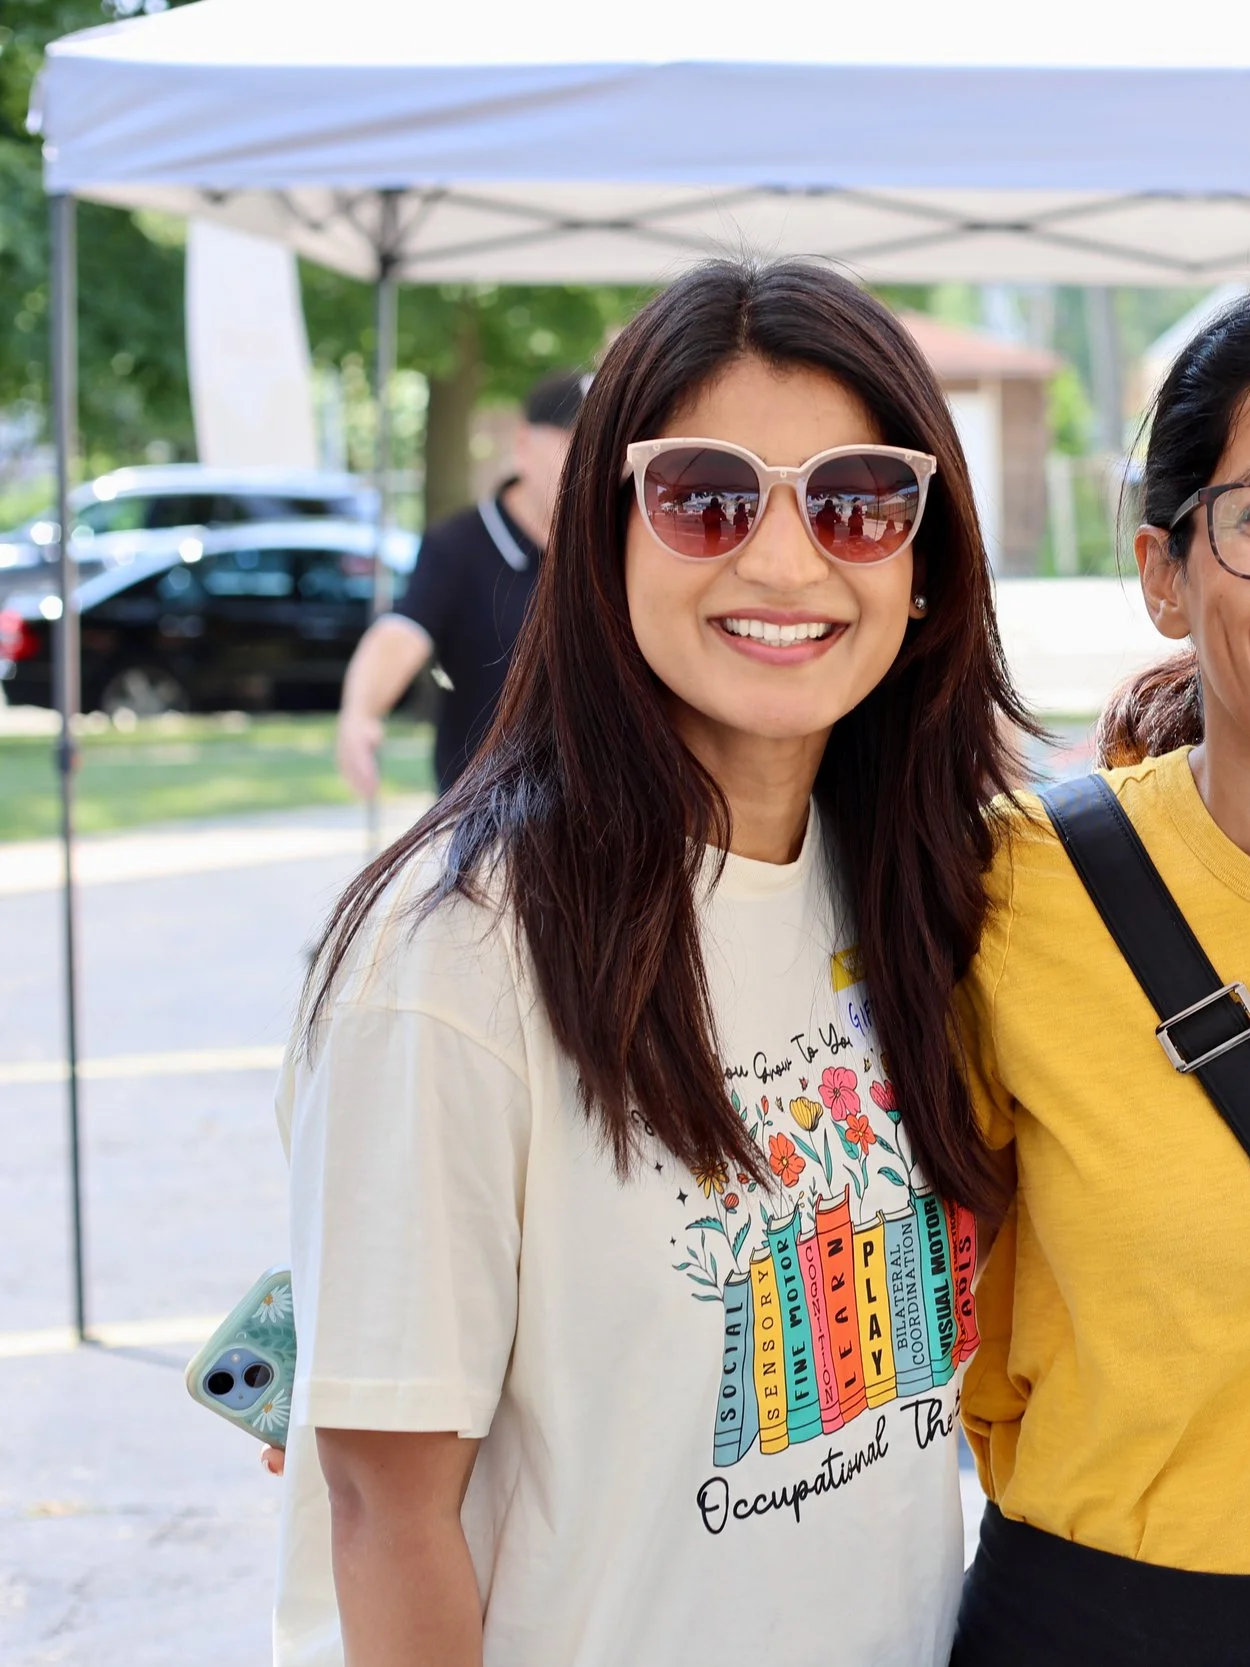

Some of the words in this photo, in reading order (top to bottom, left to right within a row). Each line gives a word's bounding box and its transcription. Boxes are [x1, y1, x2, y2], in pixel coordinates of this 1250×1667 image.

[724, 1065, 748, 1079] ou
[753, 1051, 792, 1084] Grow
[791, 1033, 818, 1063] To
[777, 1237, 803, 1329] MOTOR
[901, 1222, 925, 1365] COORDINATION
[924, 1195, 946, 1277] MOTOR
[757, 1270, 780, 1421] SENSORY
[805, 1246, 834, 1404] COGNITION
[827, 1238, 857, 1389] LEARN
[862, 1240, 883, 1376] PLAY
[890, 1244, 908, 1351] BILATERAL
[933, 1278, 954, 1356] VISUAL
[720, 1301, 743, 1421] SOCIAL
[792, 1341, 810, 1401] FINE
[697, 1415, 889, 1534] Occupational
